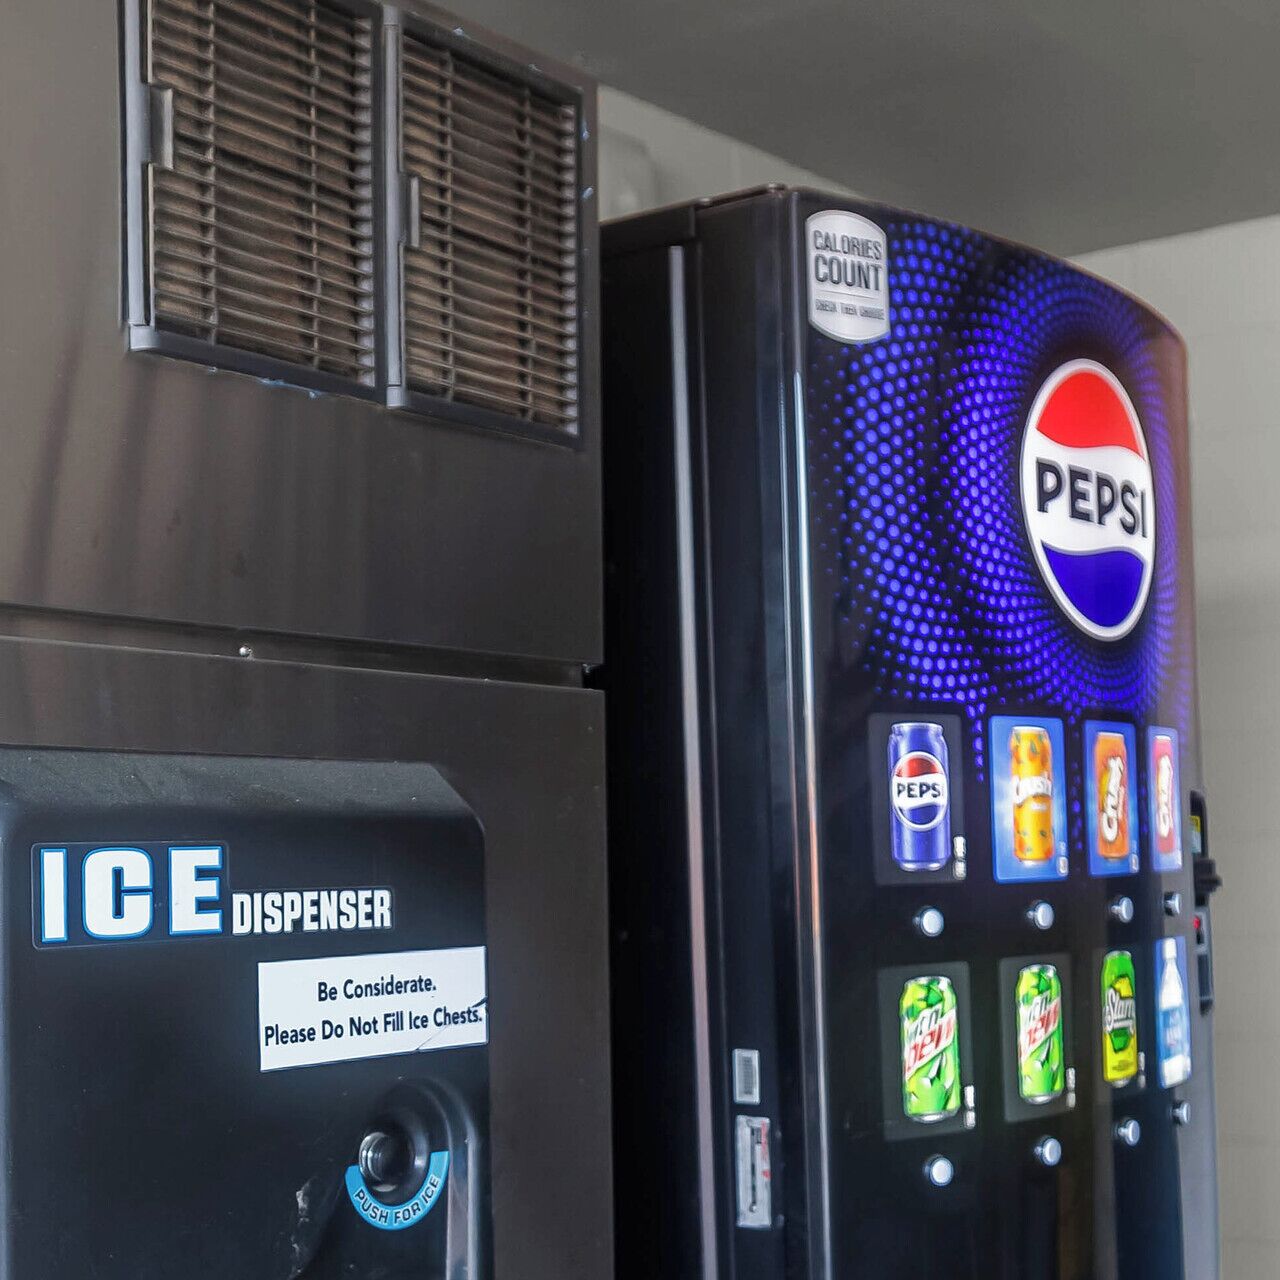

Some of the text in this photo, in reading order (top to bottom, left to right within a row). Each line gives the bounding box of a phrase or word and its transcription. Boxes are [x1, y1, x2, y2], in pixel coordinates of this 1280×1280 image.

[814, 230, 882, 260] CALORIES
[815, 254, 881, 291] COUNT
[1036, 457, 1147, 538] PEPSI
[40, 846, 392, 943] ICE DISPENSER
[318, 974, 436, 1002] Be Considerate.
[264, 1006, 483, 1046] Please Do Not Fill Ice Chests.
[354, 1174, 440, 1224] PUSH FOR ICE
